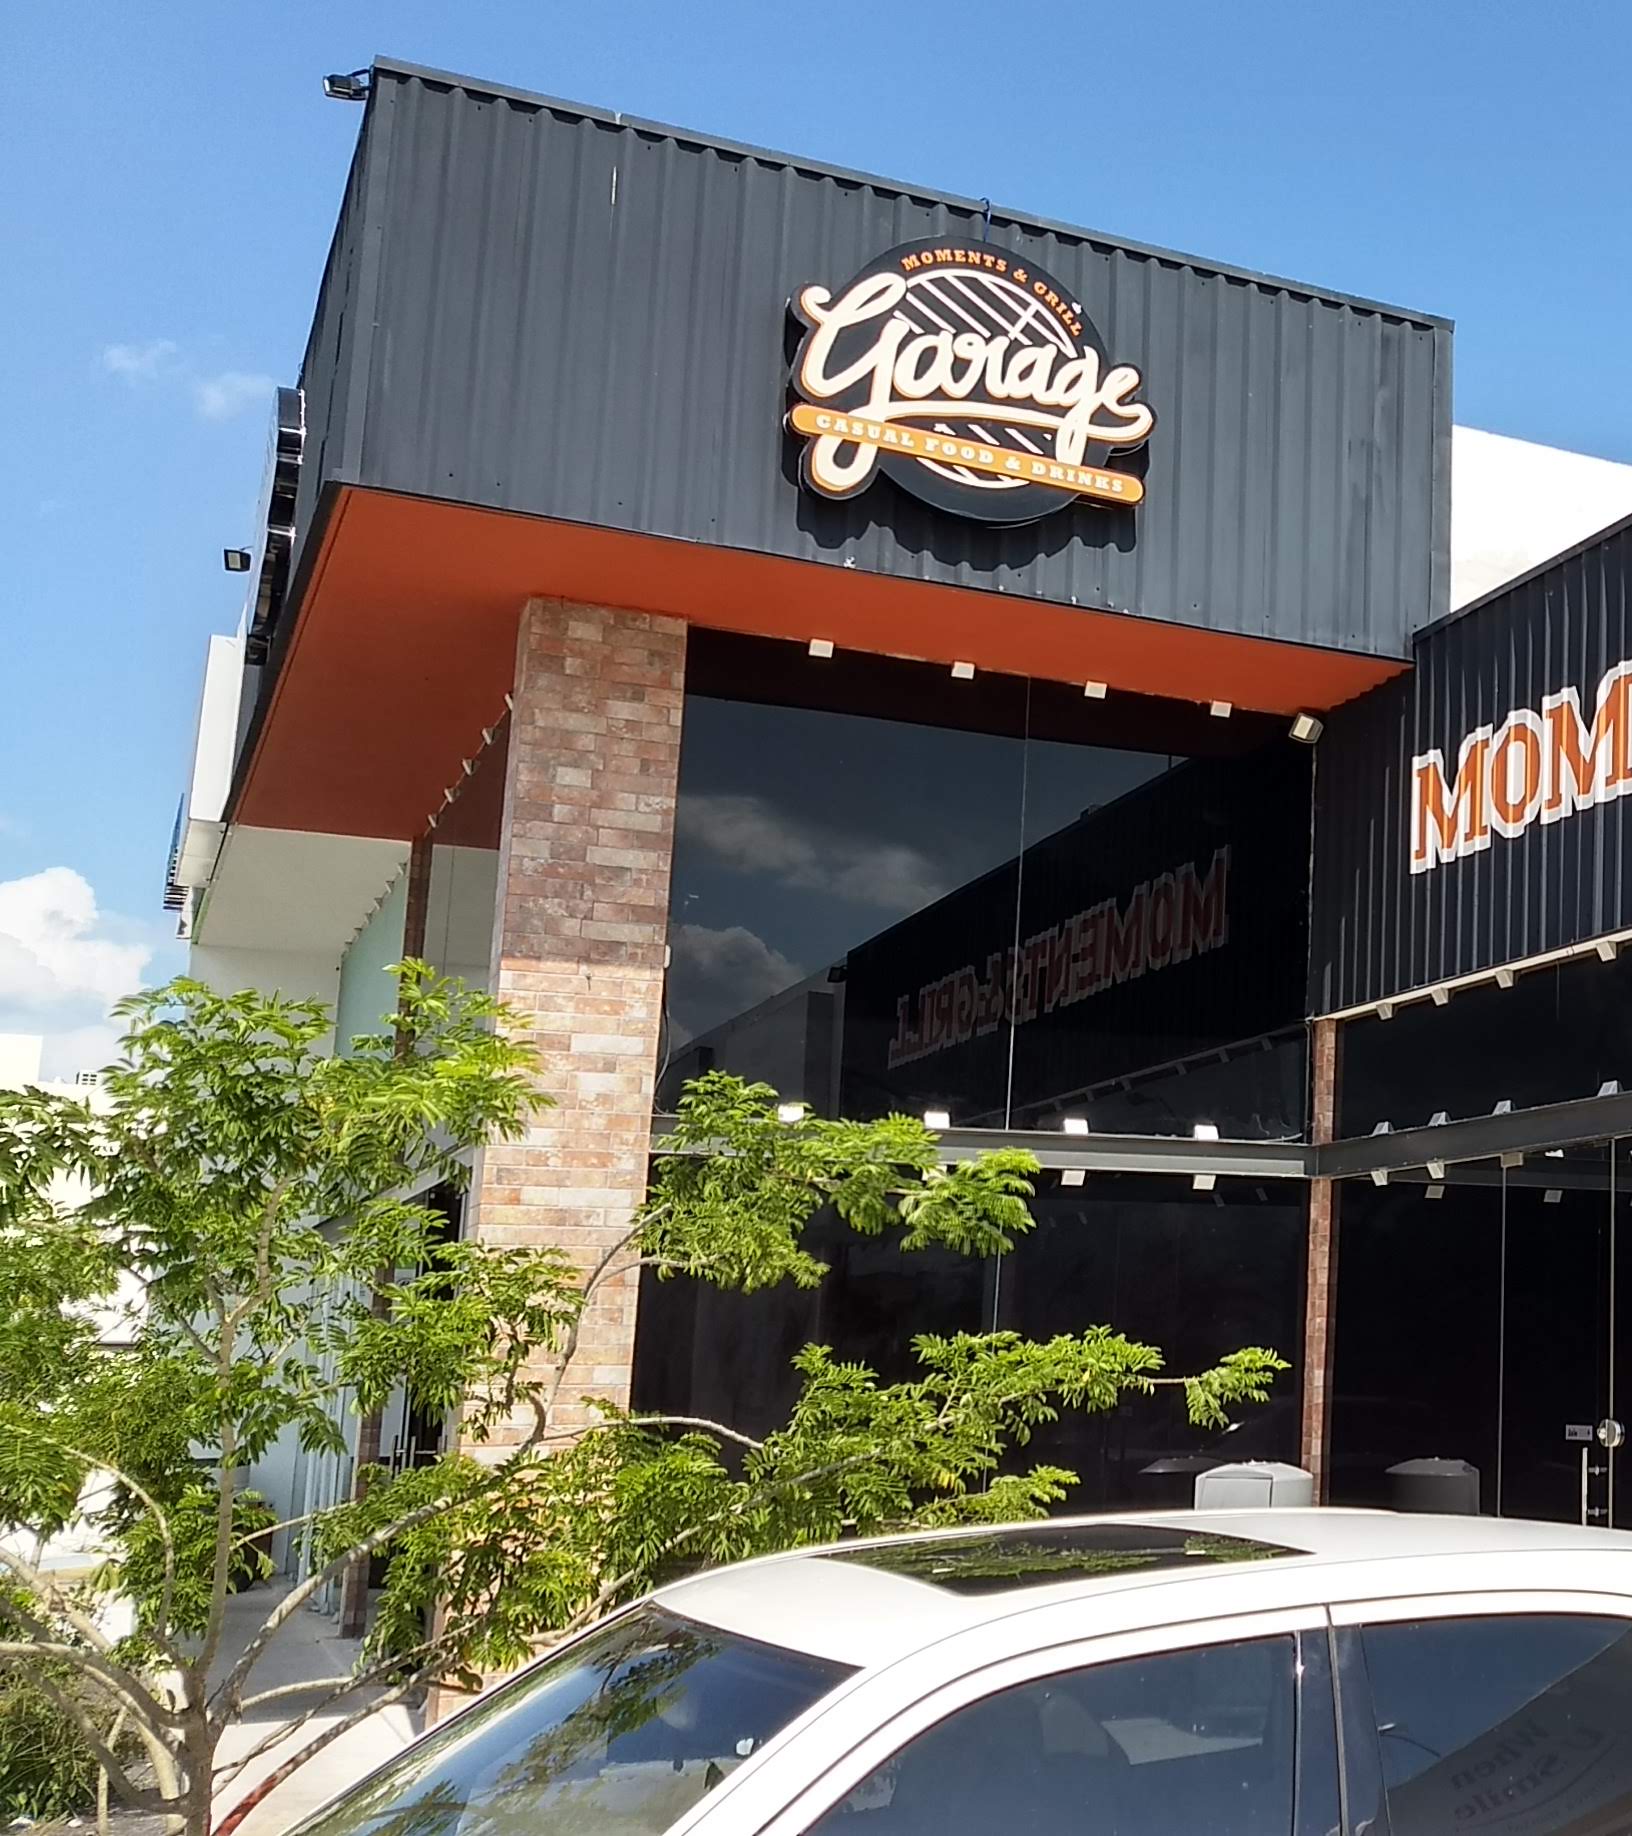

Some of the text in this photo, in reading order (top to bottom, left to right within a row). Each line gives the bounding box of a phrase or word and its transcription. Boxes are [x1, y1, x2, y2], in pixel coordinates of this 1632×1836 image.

[901, 249, 1082, 337] MOMENTS & GRILL
[800, 272, 1153, 491] Garage
[816, 414, 1123, 493] CASUAL FOOD & DRINKS
